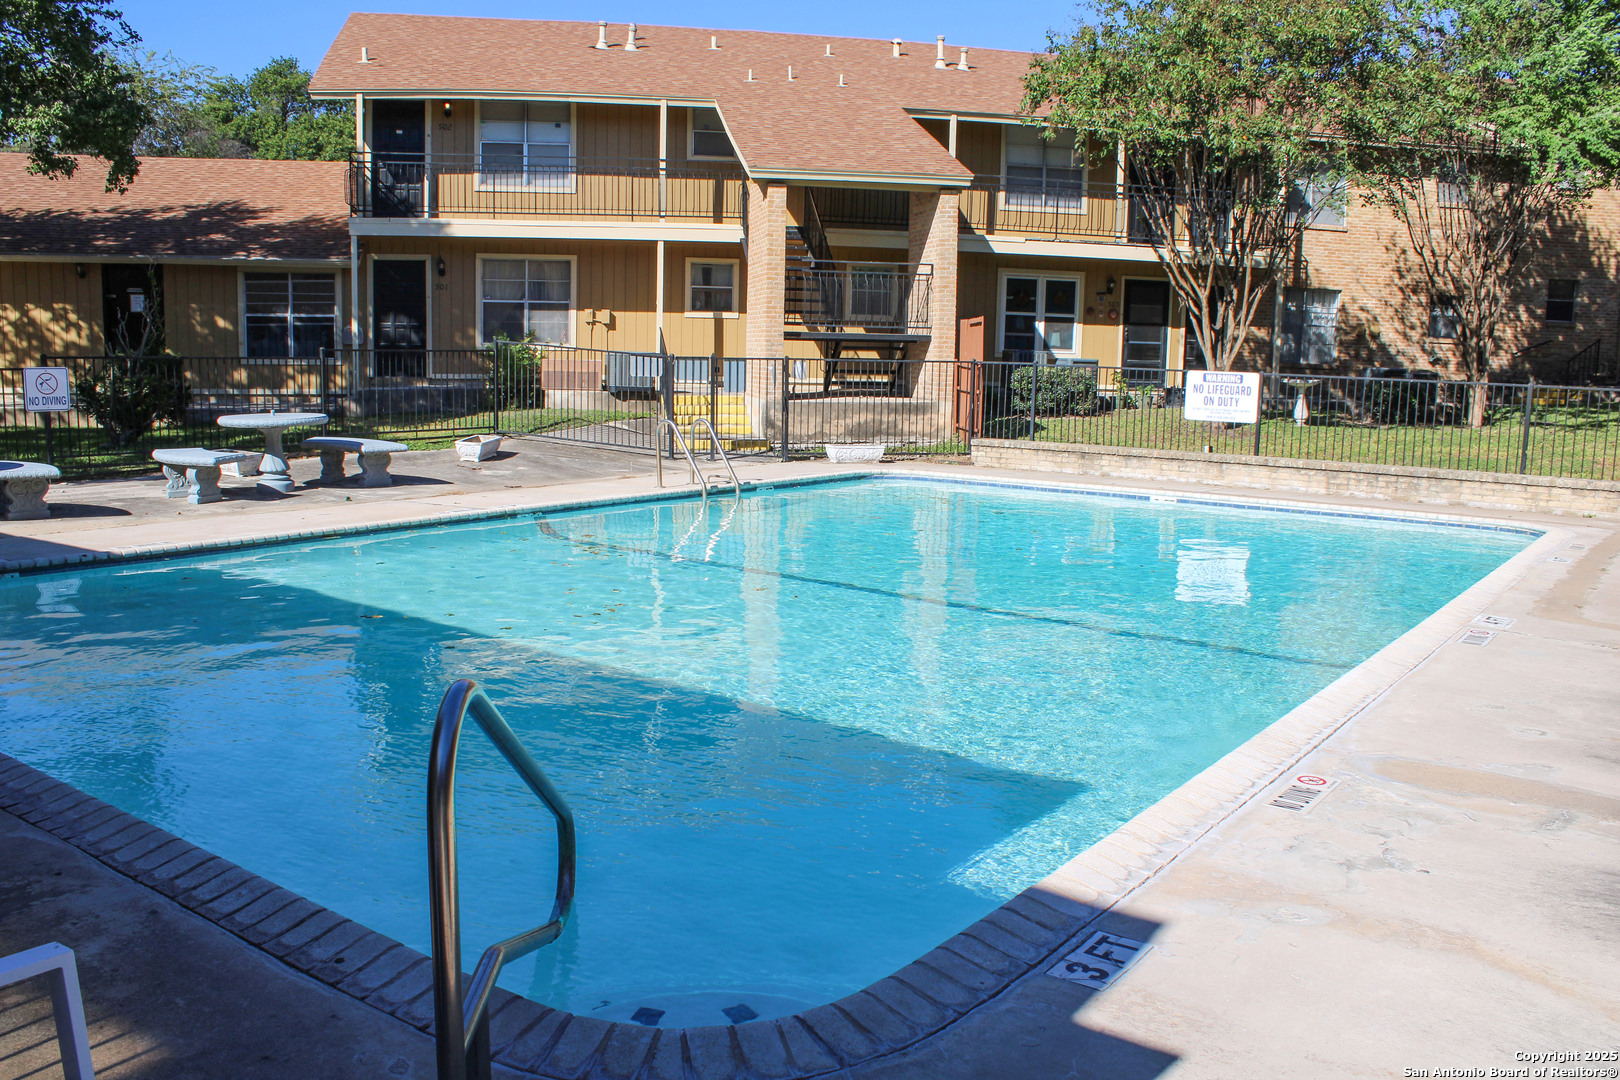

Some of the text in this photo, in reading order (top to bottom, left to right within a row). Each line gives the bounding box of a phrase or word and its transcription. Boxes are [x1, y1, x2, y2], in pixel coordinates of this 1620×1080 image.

[1205, 373, 1242, 383] WARNING
[1193, 383, 1252, 397] NO LIFEGUARD
[28, 395, 67, 406] NO DIVING
[1203, 395, 1240, 408] ON DUTY
[1065, 934, 1141, 981] 3 FT
